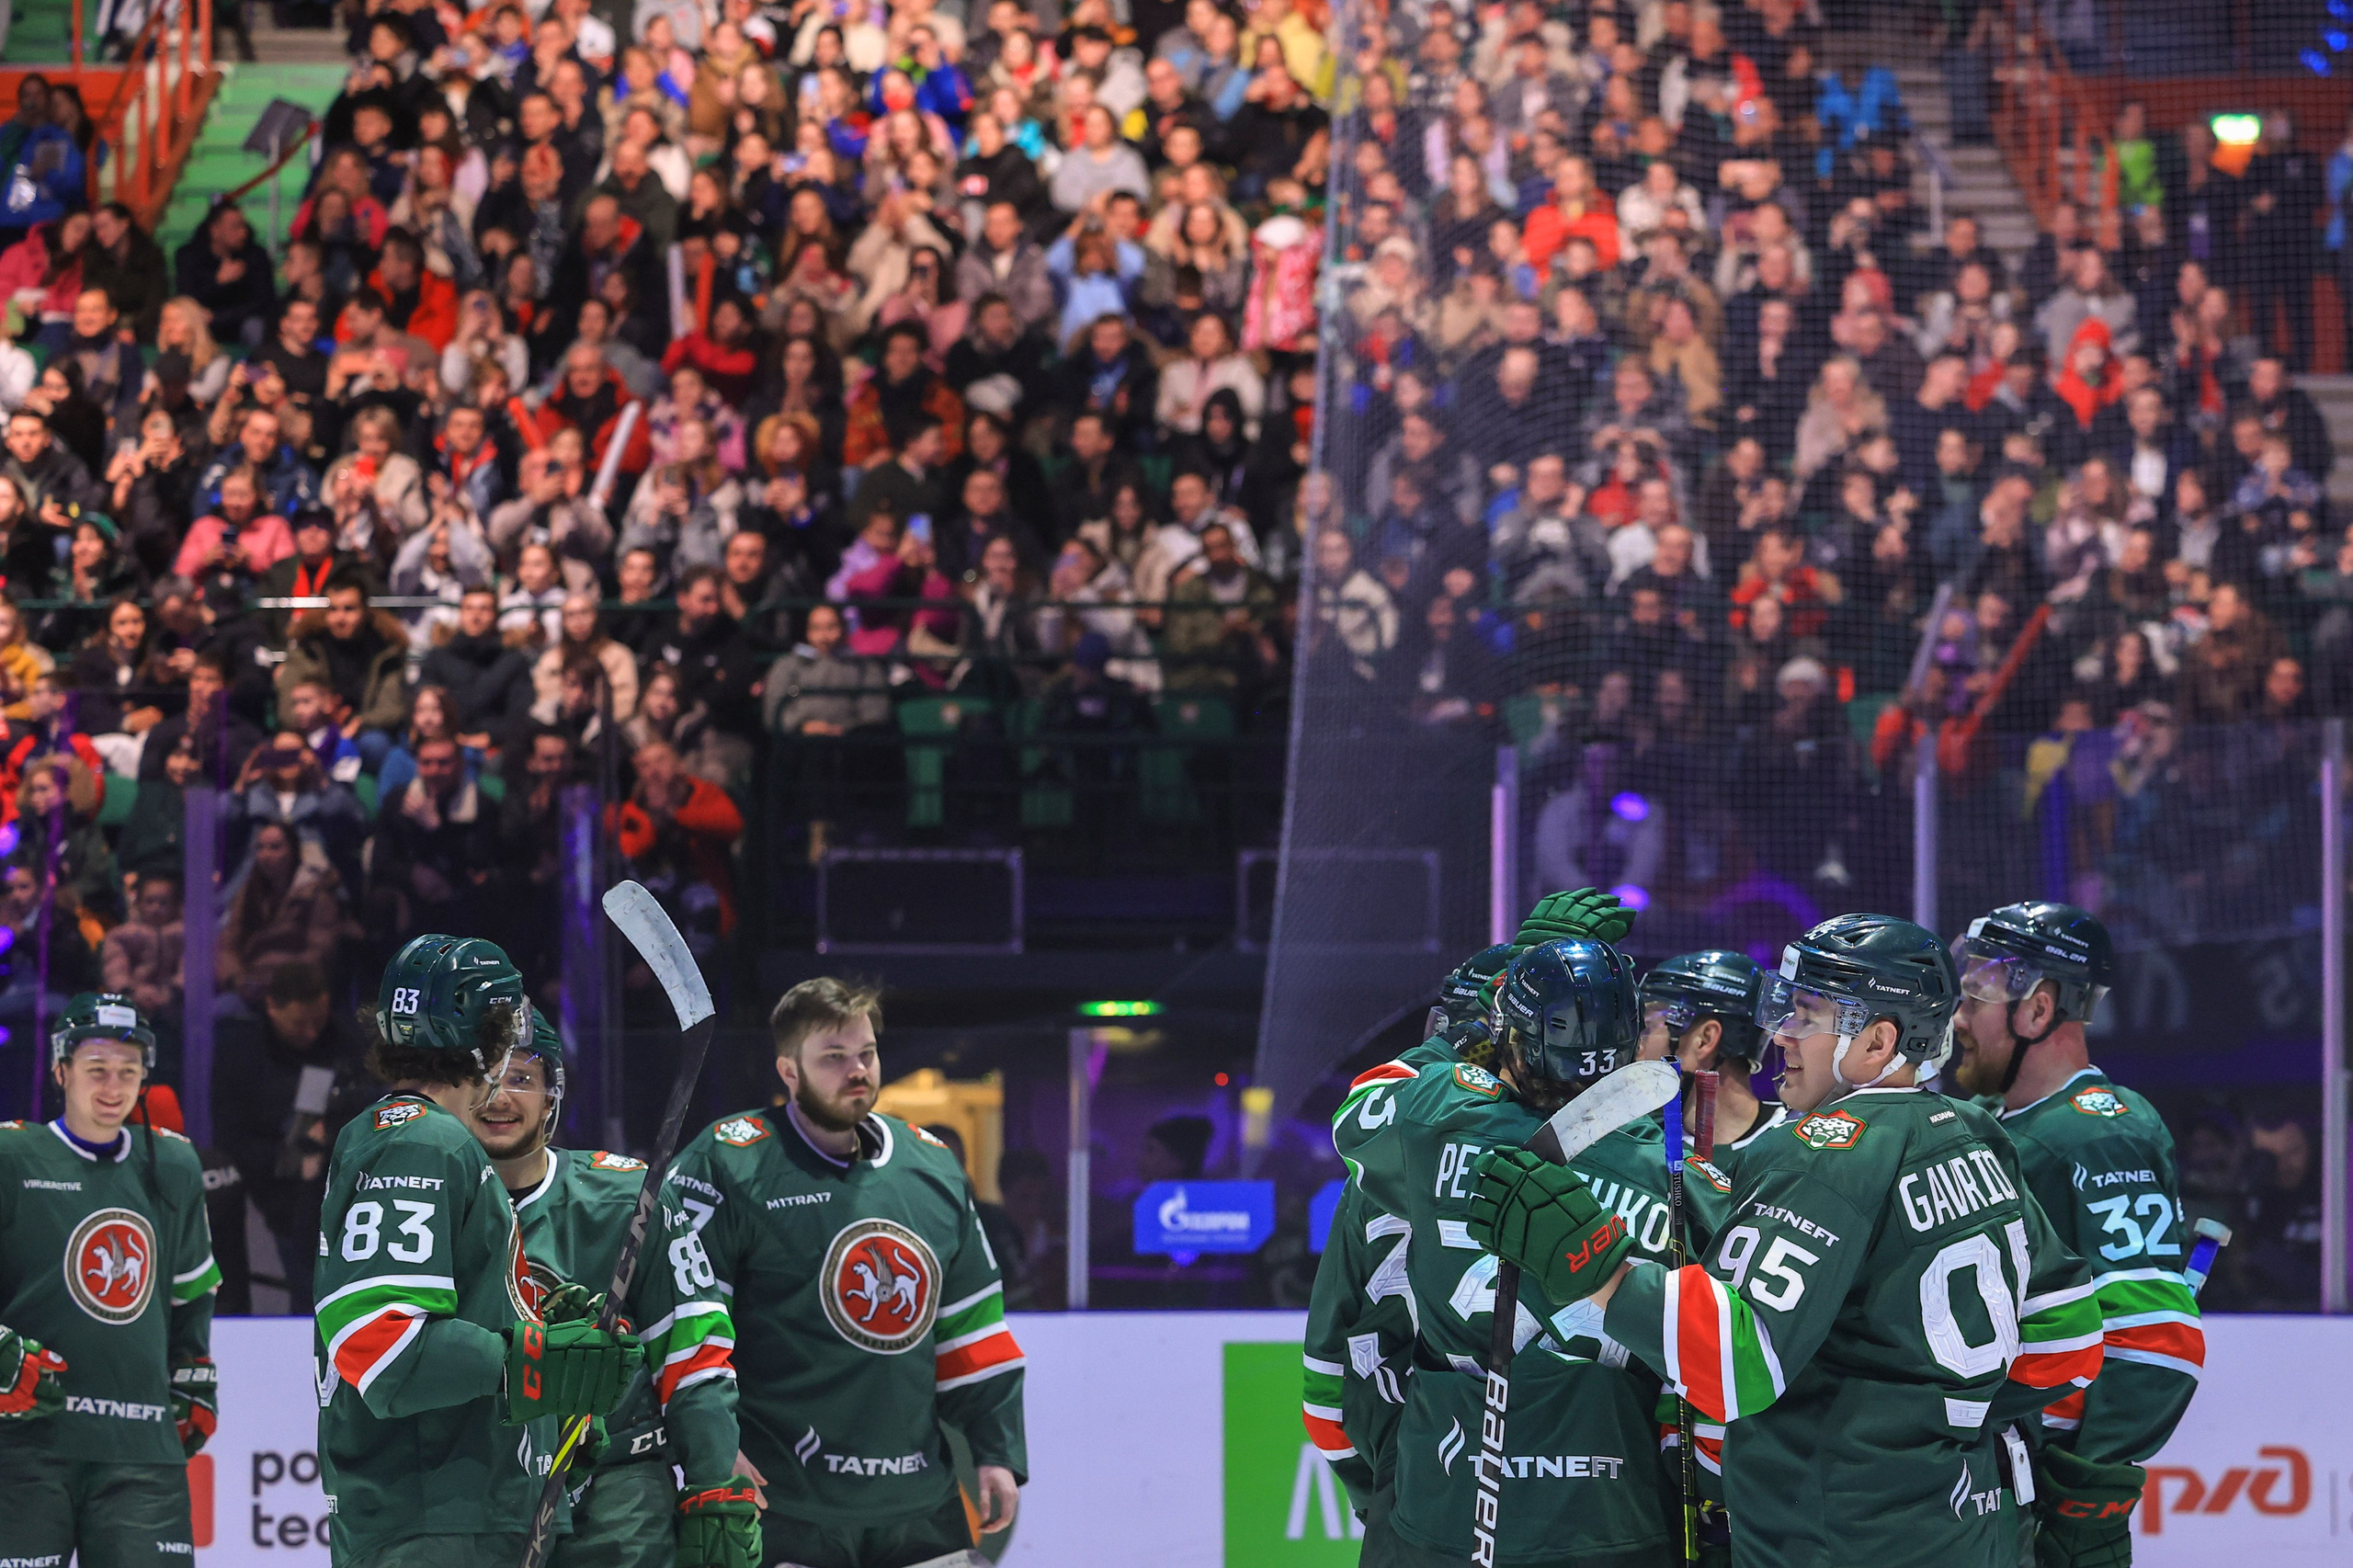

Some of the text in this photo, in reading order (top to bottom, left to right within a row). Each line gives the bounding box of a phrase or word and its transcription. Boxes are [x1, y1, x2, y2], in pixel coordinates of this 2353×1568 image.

[392, 987, 420, 1015] 83
[489, 995, 512, 1005] CCM
[1453, 986, 1478, 997] BAUE
[1521, 979, 1540, 998] TATNEFT
[1875, 984, 1910, 995] TATNEFT
[1507, 994, 1534, 1017] BAUER
[1579, 1049, 1618, 1076] 33
[1929, 1110, 1956, 1124] КАЗАНЬ
[341, 1199, 436, 1264] 83
[1754, 1202, 1840, 1248] TATNEFT
[2086, 1193, 2181, 1262] 32
[668, 1230, 715, 1297] 88
[1717, 1225, 1821, 1312] 95
[65, 1395, 166, 1423] TATNEFT
[1472, 1369, 1509, 1568] BAUER
[0, 1553, 63, 1568] ATNEFT
